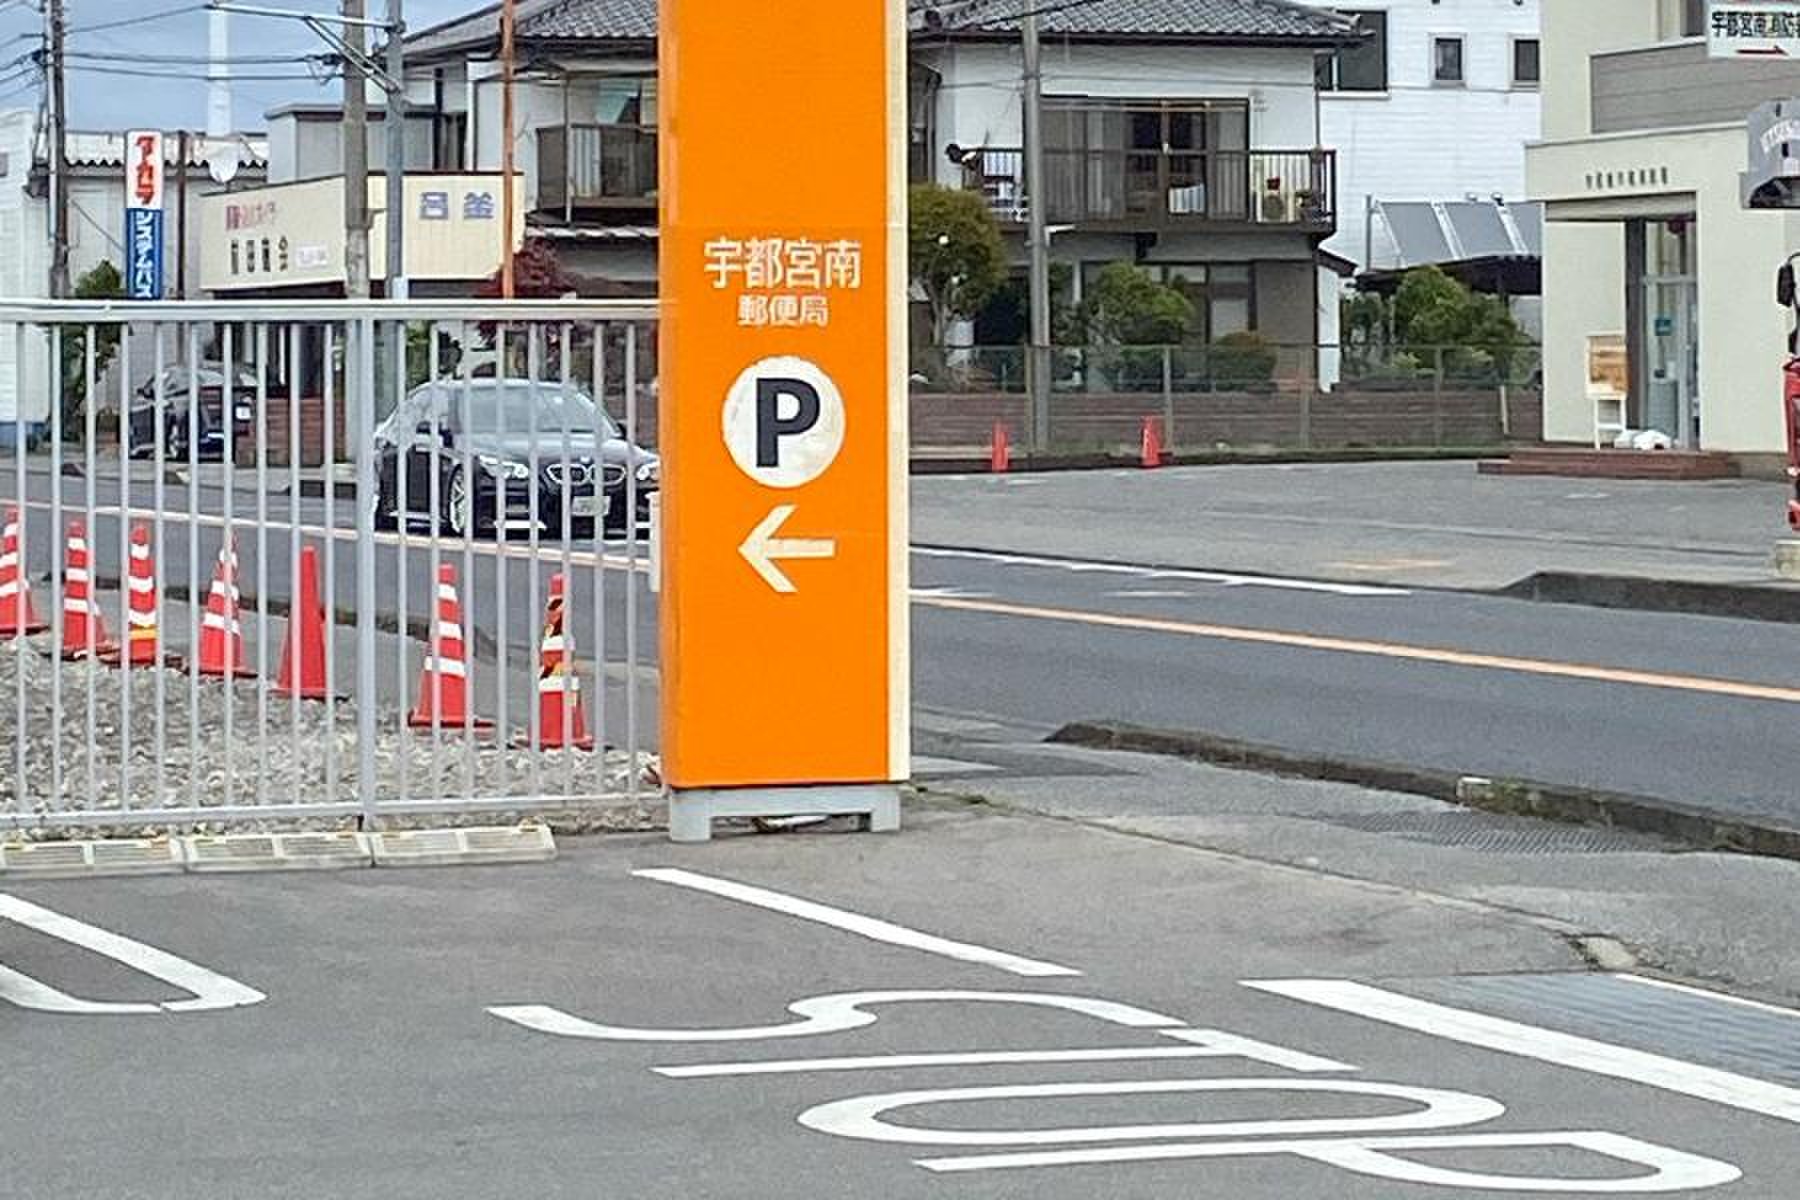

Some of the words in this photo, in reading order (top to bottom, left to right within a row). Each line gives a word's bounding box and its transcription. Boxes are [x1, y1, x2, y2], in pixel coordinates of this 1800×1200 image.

[136, 136, 155, 205] タカラ
[704, 236, 861, 288] 宇都宮南
[738, 294, 829, 326] 郵便局
[755, 377, 821, 468] P
[484, 989, 1744, 1192] STOP
